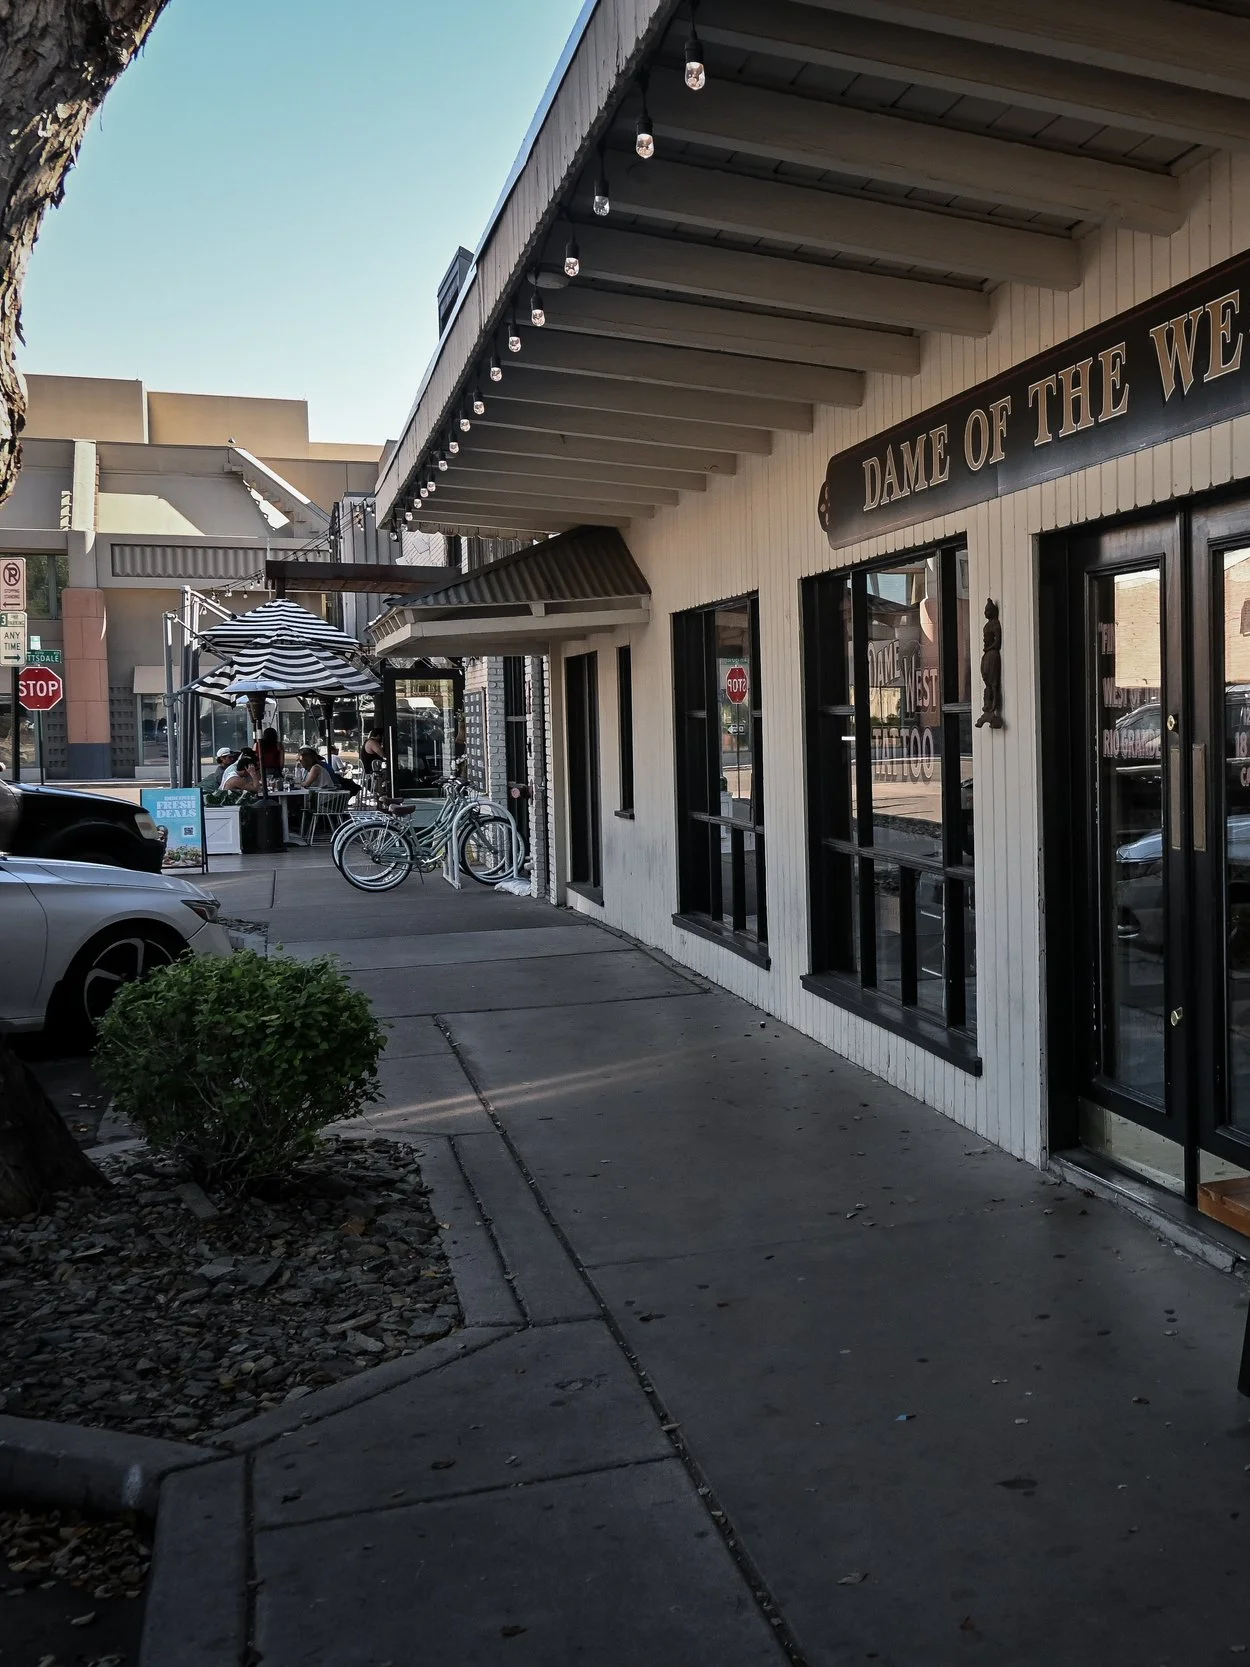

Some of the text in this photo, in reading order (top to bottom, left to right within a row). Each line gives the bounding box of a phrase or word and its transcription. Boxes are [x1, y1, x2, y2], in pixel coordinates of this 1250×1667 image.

[862, 424, 951, 513] DAME
[963, 396, 1013, 472] OF
[1028, 341, 1131, 448] THE
[4, 632, 20, 640] ANY
[4, 643, 21, 651] TIME
[27, 655, 60, 663] TTSDALE
[867, 639, 901, 687] DAME
[19, 680, 59, 697] STOP
[903, 654, 938, 714] WEST
[872, 728, 935, 780] TATTOO
[1103, 729, 1120, 758] RIO
[1235, 731, 1248, 758] 18
[156, 800, 196, 810] FRESH
[156, 809, 196, 818] DEALS
